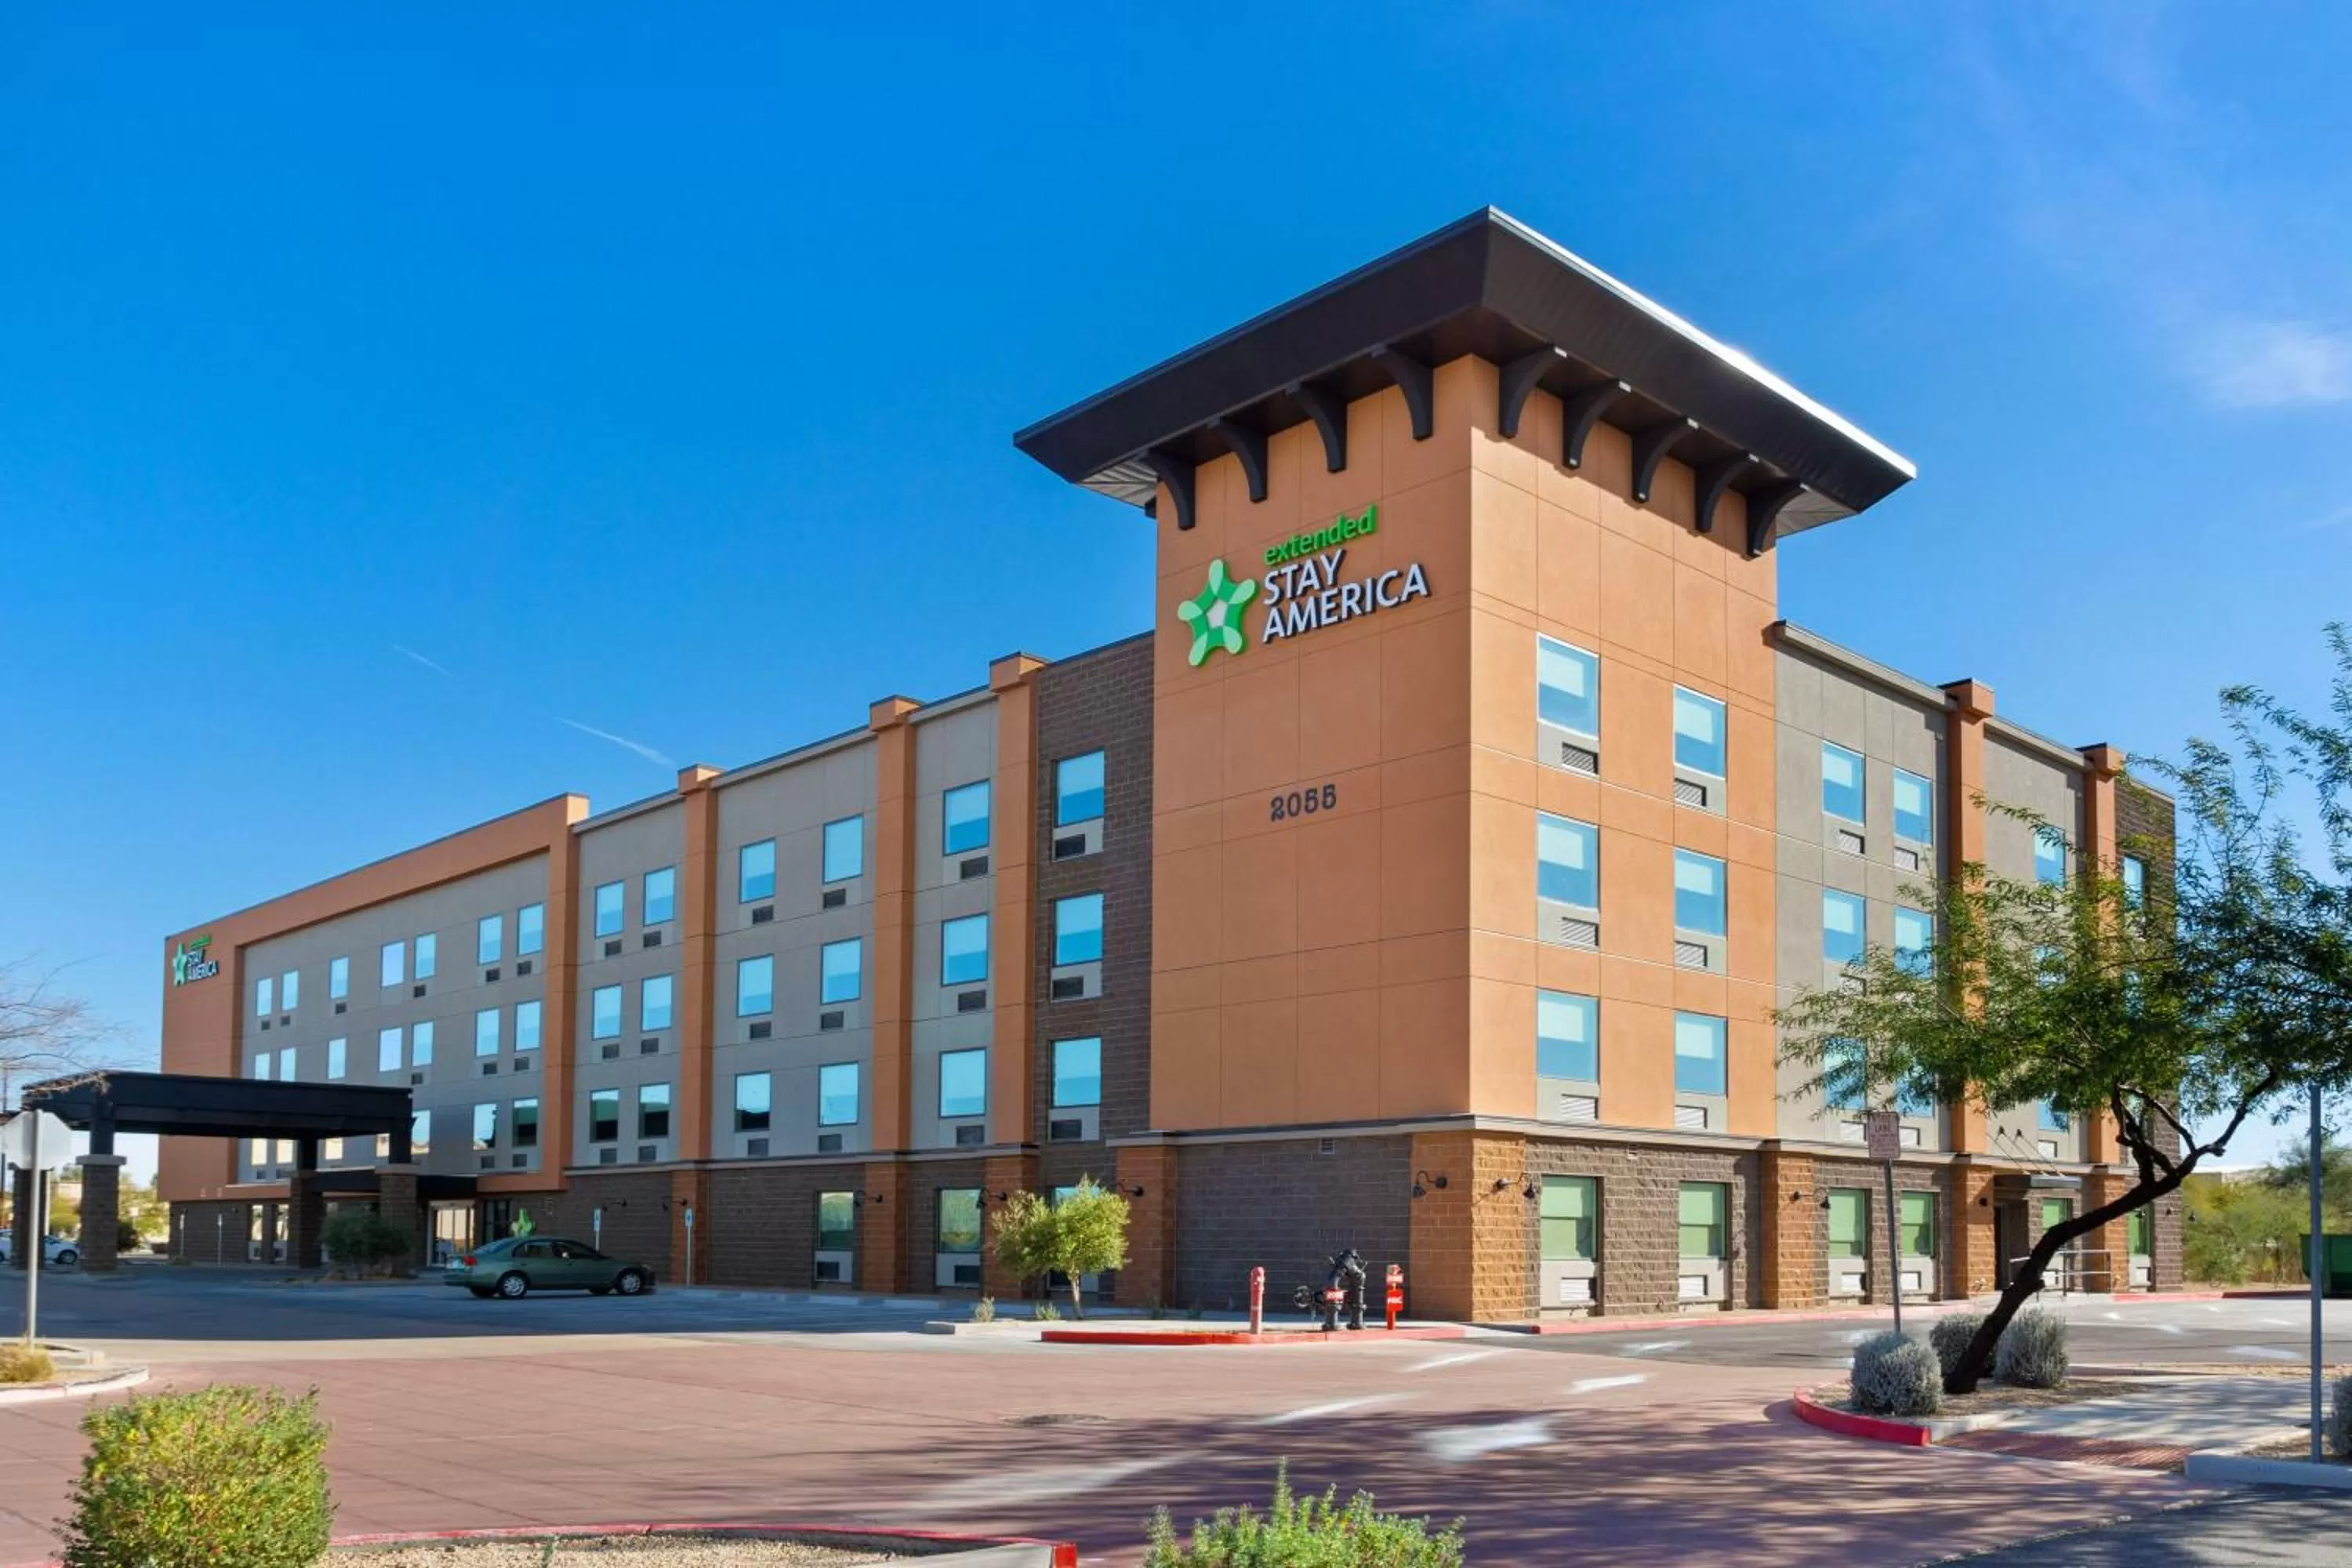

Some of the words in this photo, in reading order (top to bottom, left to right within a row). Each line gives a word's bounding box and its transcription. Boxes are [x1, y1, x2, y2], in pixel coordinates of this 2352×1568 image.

[1263, 503, 1377, 566] extended
[1261, 562, 1430, 644] AMERICA
[1263, 548, 1345, 606] STAY
[1270, 784, 1337, 822] 2055
